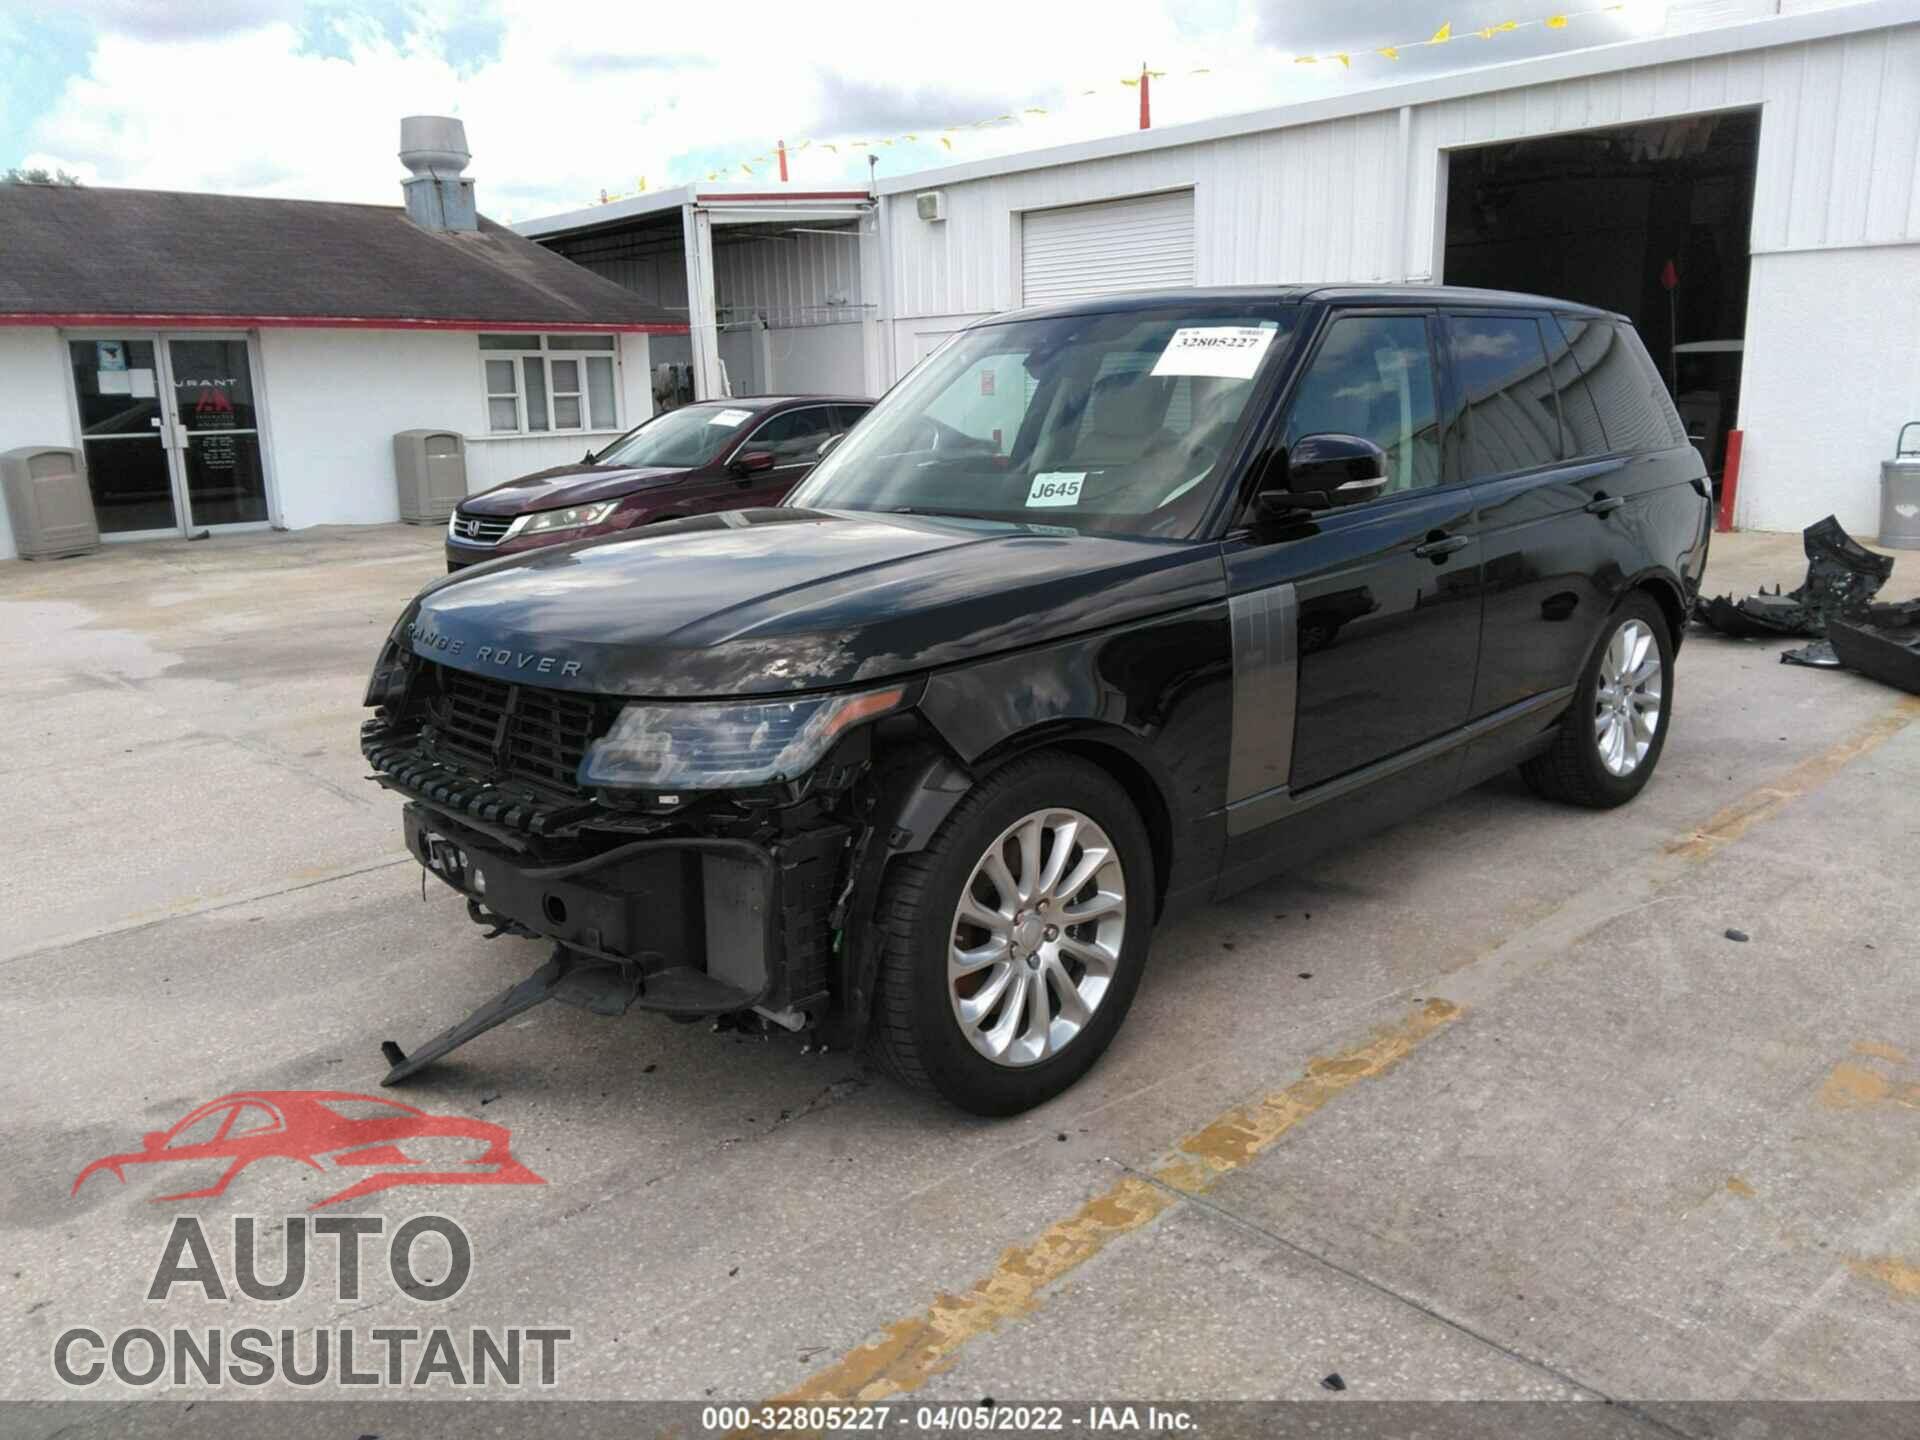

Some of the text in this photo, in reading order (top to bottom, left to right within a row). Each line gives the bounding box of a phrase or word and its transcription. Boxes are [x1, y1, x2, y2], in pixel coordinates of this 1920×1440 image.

[1176, 336, 1259, 349] 32805227
[1031, 481, 1079, 499] J645
[407, 623, 582, 677] RANGE ROVER
